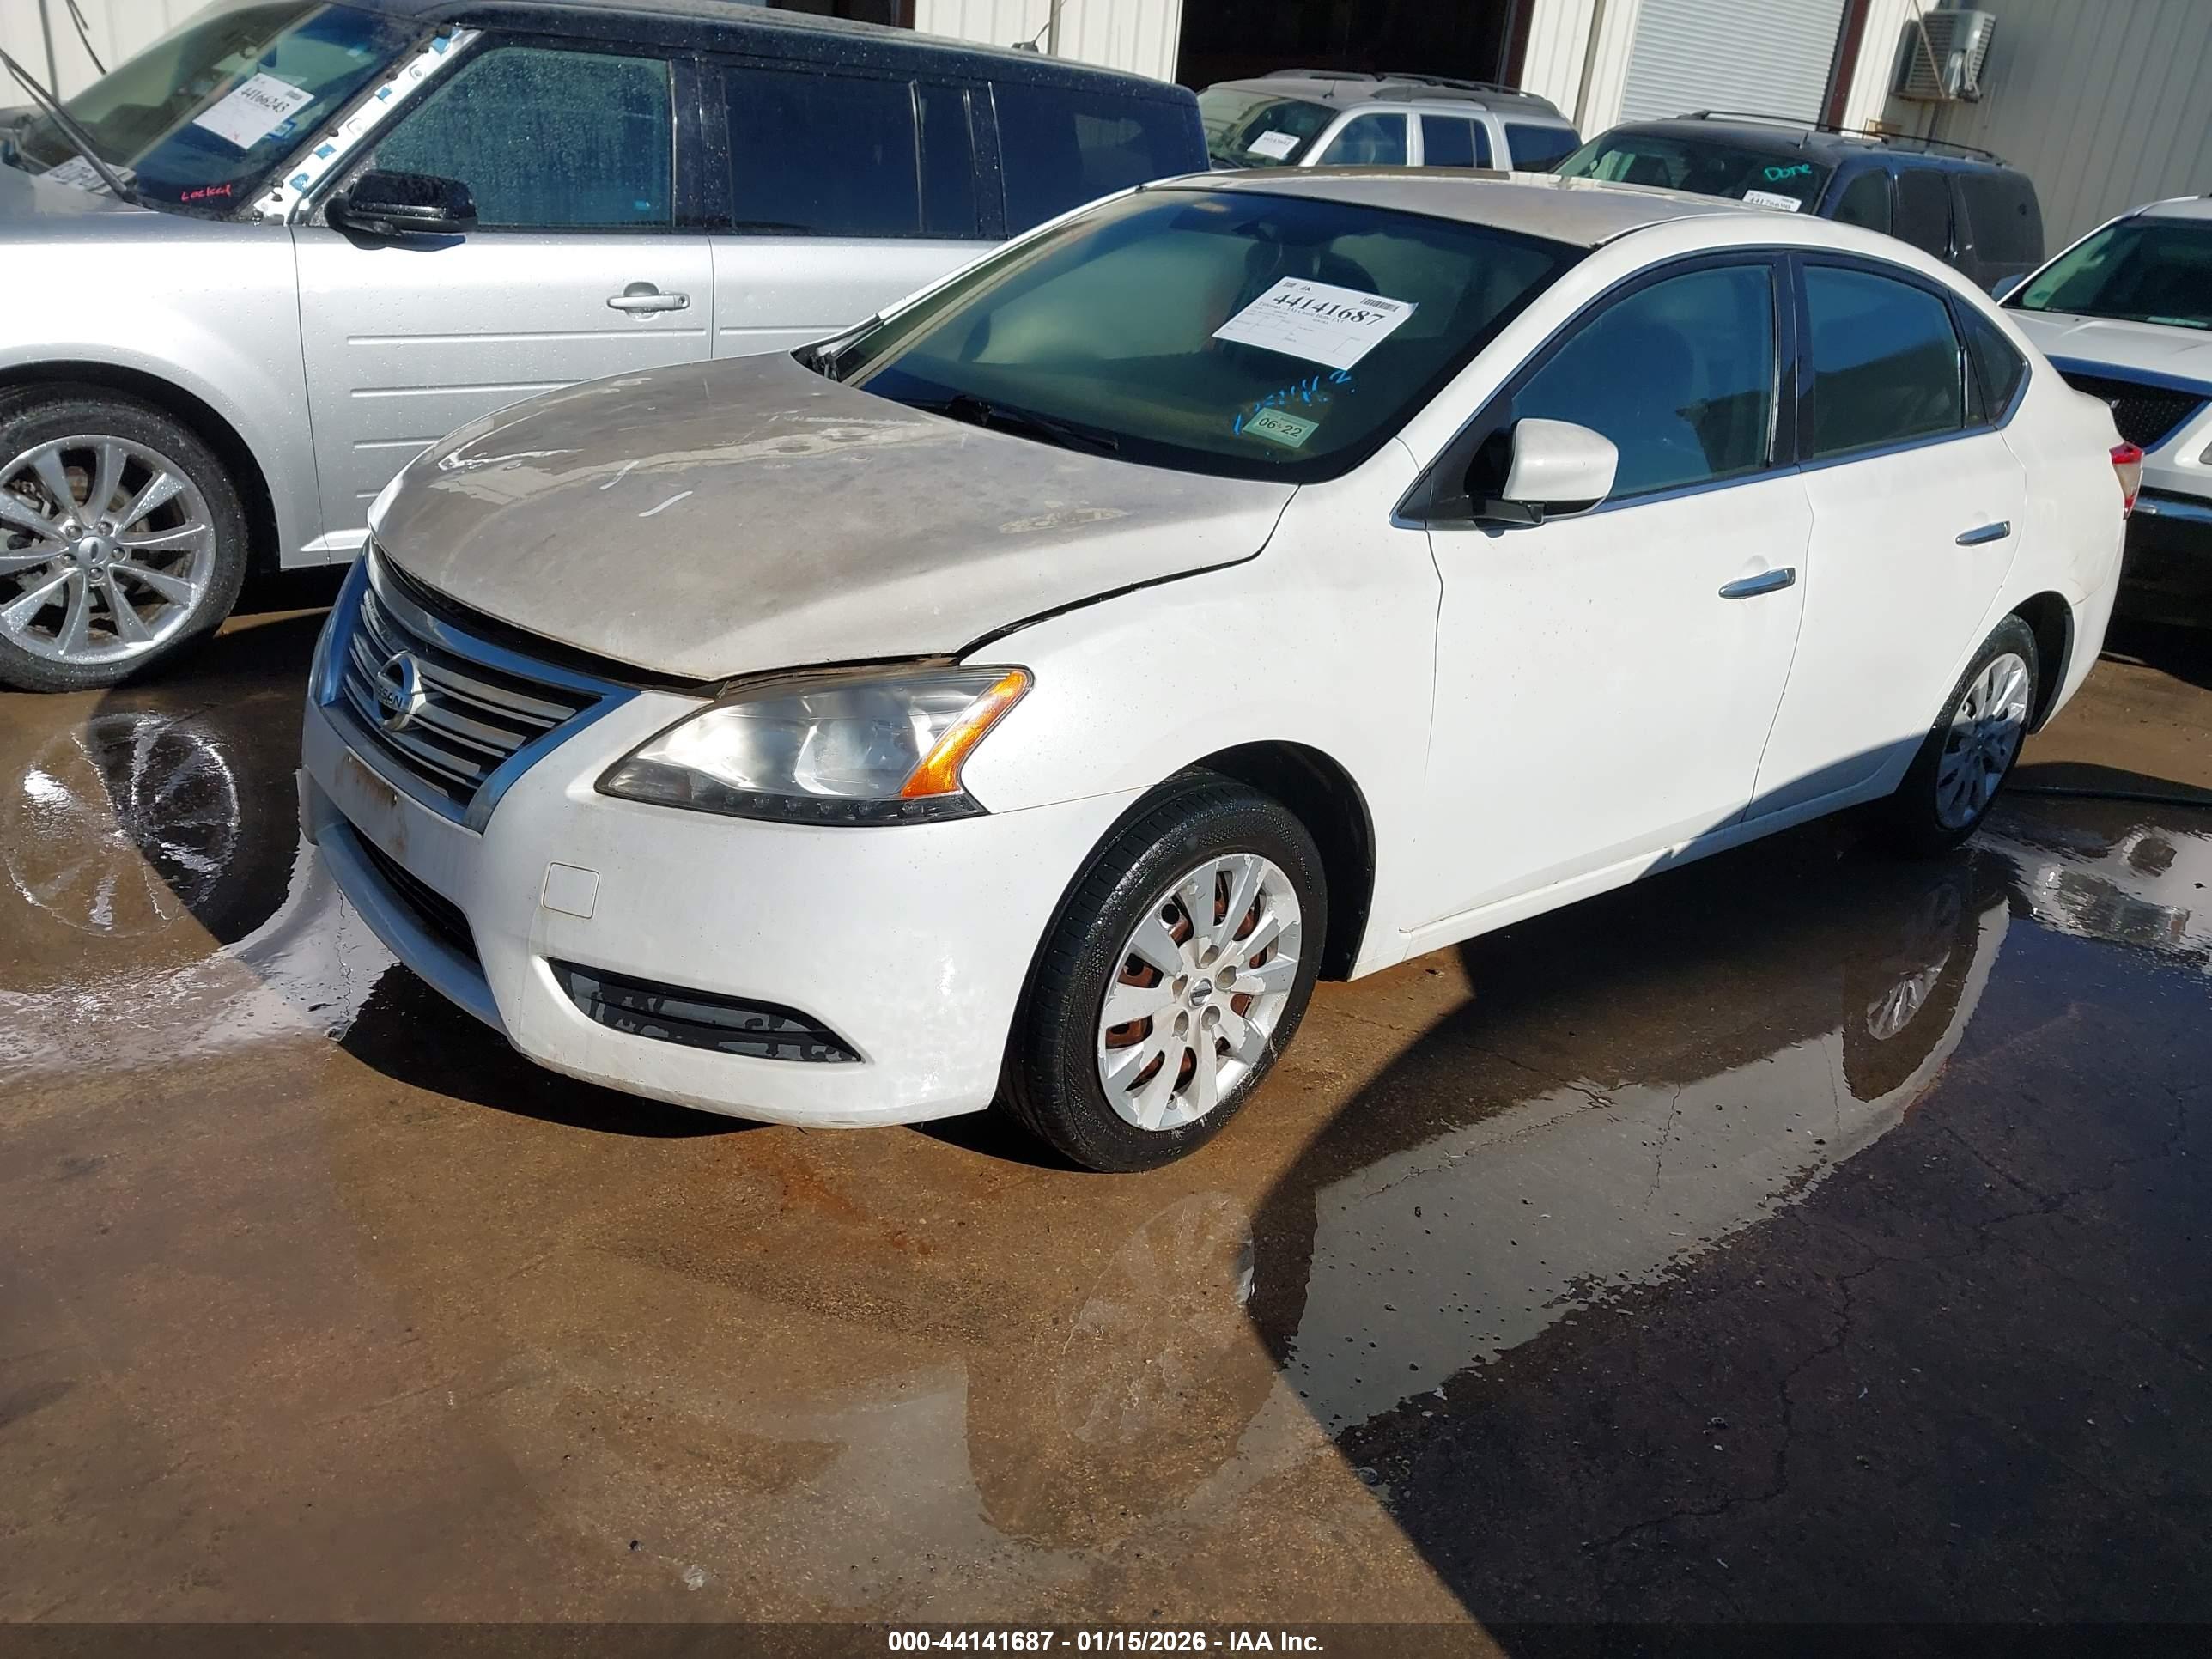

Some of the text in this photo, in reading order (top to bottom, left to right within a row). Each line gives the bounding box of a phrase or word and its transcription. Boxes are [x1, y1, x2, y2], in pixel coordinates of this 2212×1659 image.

[1765, 163, 1812, 181] Done
[1273, 294, 1385, 325] 44141687
[1258, 417, 1278, 429] 06
[1281, 425, 1303, 437] 22
